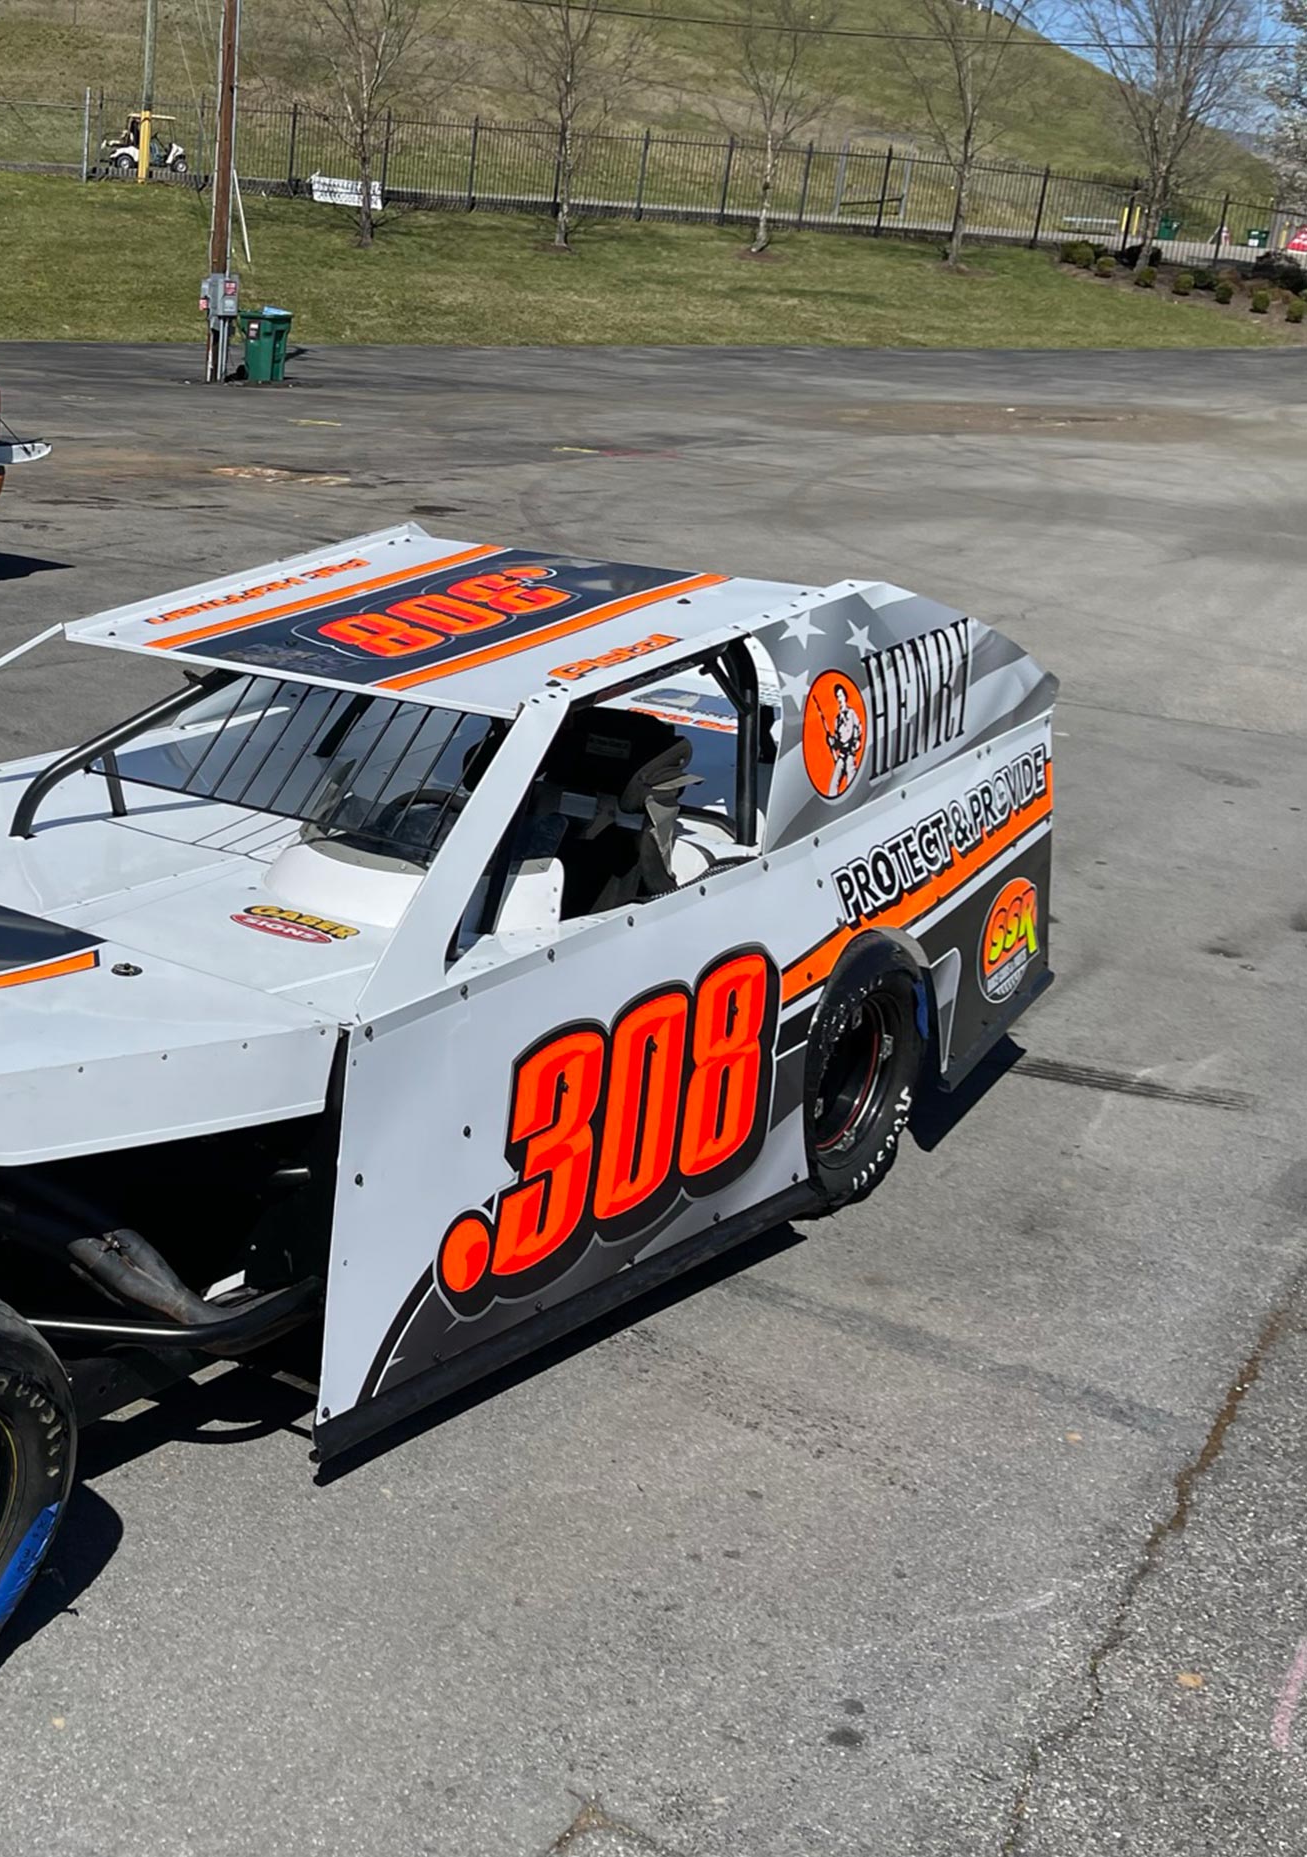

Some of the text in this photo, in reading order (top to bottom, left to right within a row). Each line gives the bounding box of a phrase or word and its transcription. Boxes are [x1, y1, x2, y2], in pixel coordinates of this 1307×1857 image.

[316, 566, 573, 658] .308
[861, 617, 971, 780] HENRY
[831, 743, 1047, 930] PROTECT & PROVIDE
[988, 886, 1038, 964] SSR
[442, 952, 768, 1293] .308
